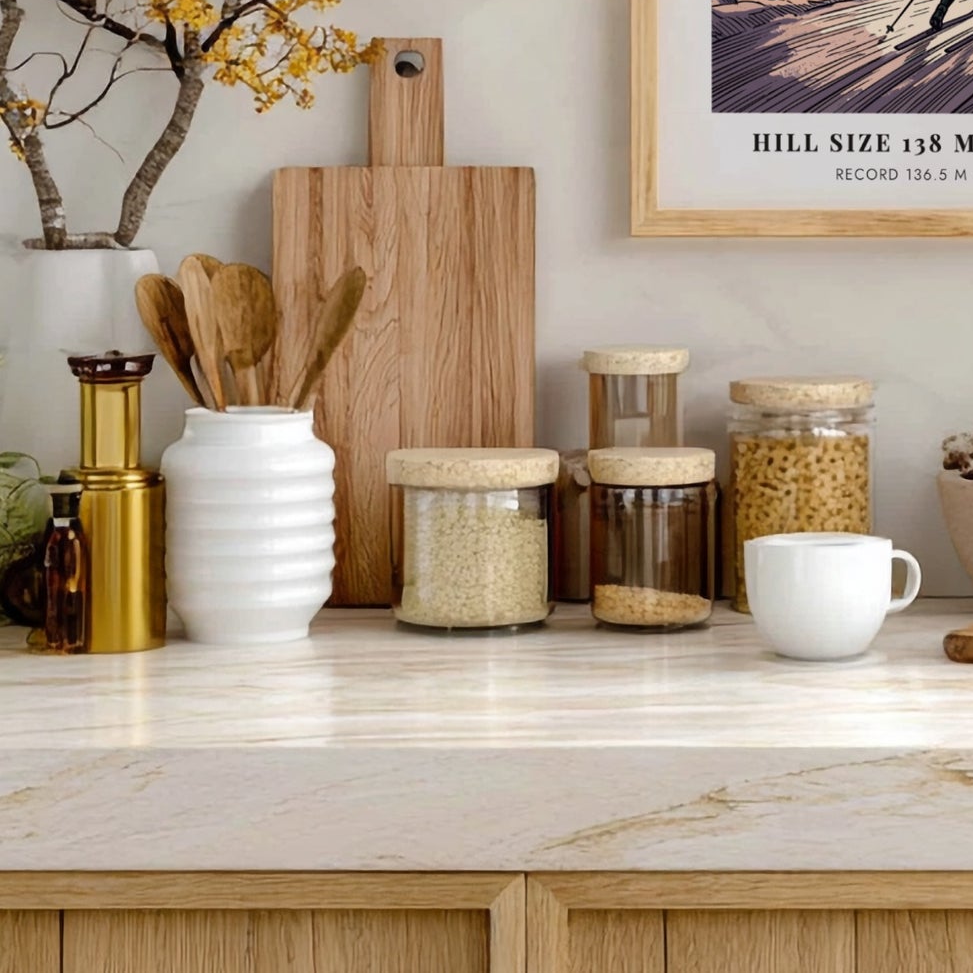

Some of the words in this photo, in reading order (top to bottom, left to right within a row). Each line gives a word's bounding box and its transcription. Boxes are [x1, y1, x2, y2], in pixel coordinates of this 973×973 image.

[752, 132, 819, 153] HILL
[829, 132, 891, 153] SIZE
[902, 133, 942, 157] 138
[835, 168, 899, 181] RECORD
[906, 168, 948, 181] 136.5
[954, 168, 967, 181] M
